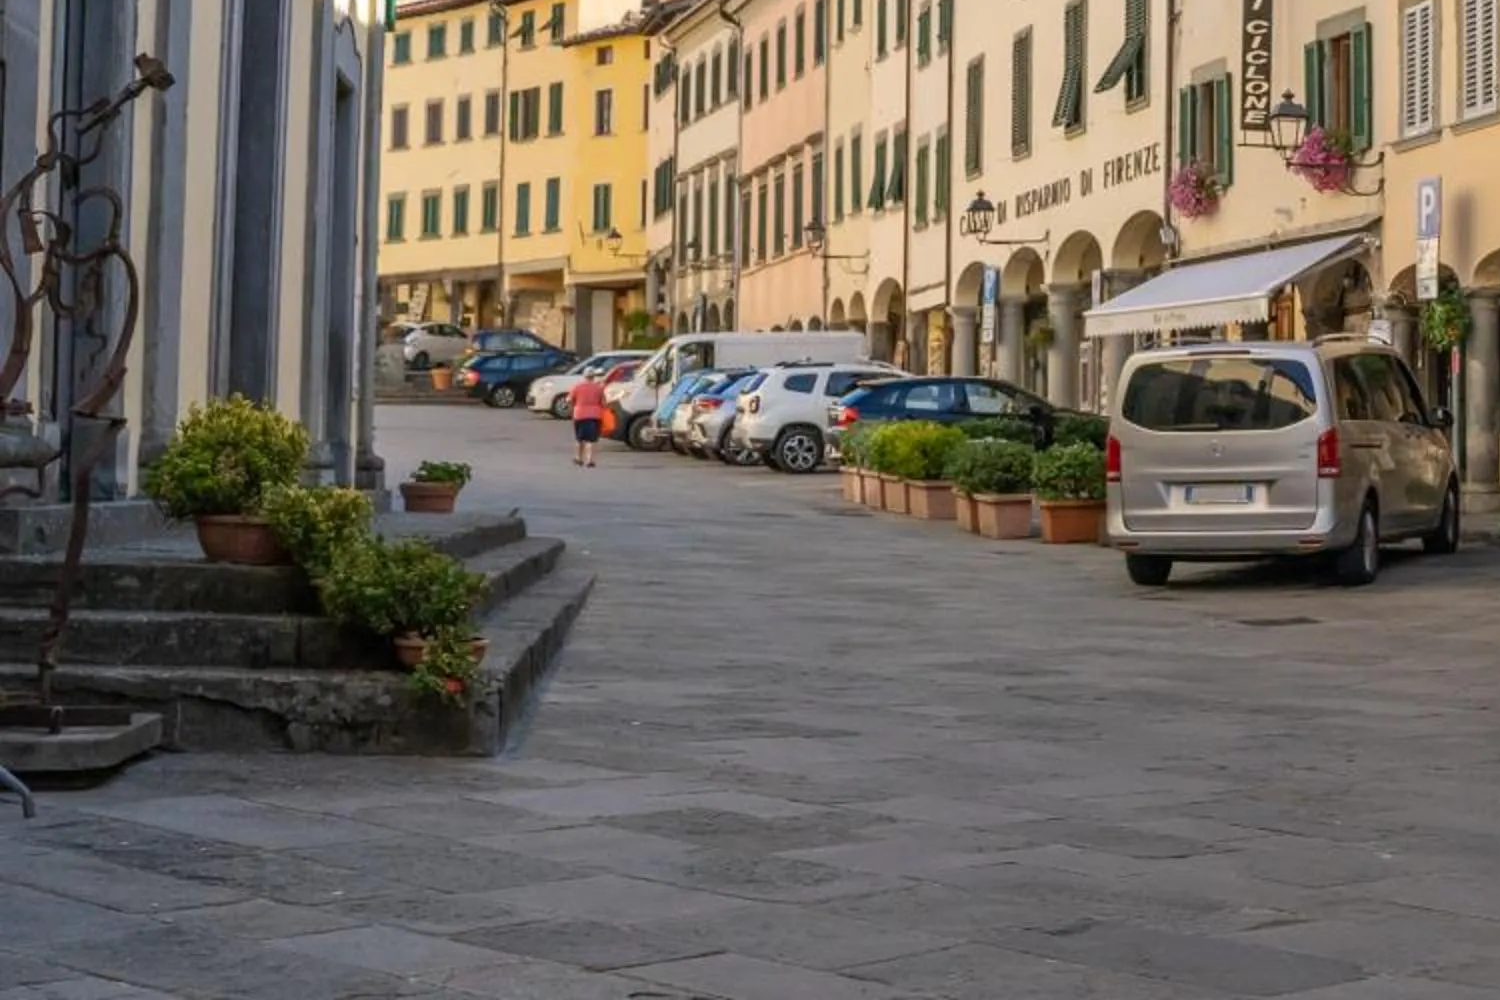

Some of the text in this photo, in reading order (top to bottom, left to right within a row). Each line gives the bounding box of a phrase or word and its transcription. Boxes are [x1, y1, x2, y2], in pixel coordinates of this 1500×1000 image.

[1244, 20, 1270, 124] CICLONE
[1015, 177, 1071, 219] RISPARMIO
[1080, 167, 1093, 198] DI
[1103, 142, 1161, 188] FIRENZE
[1421, 185, 1436, 233] P
